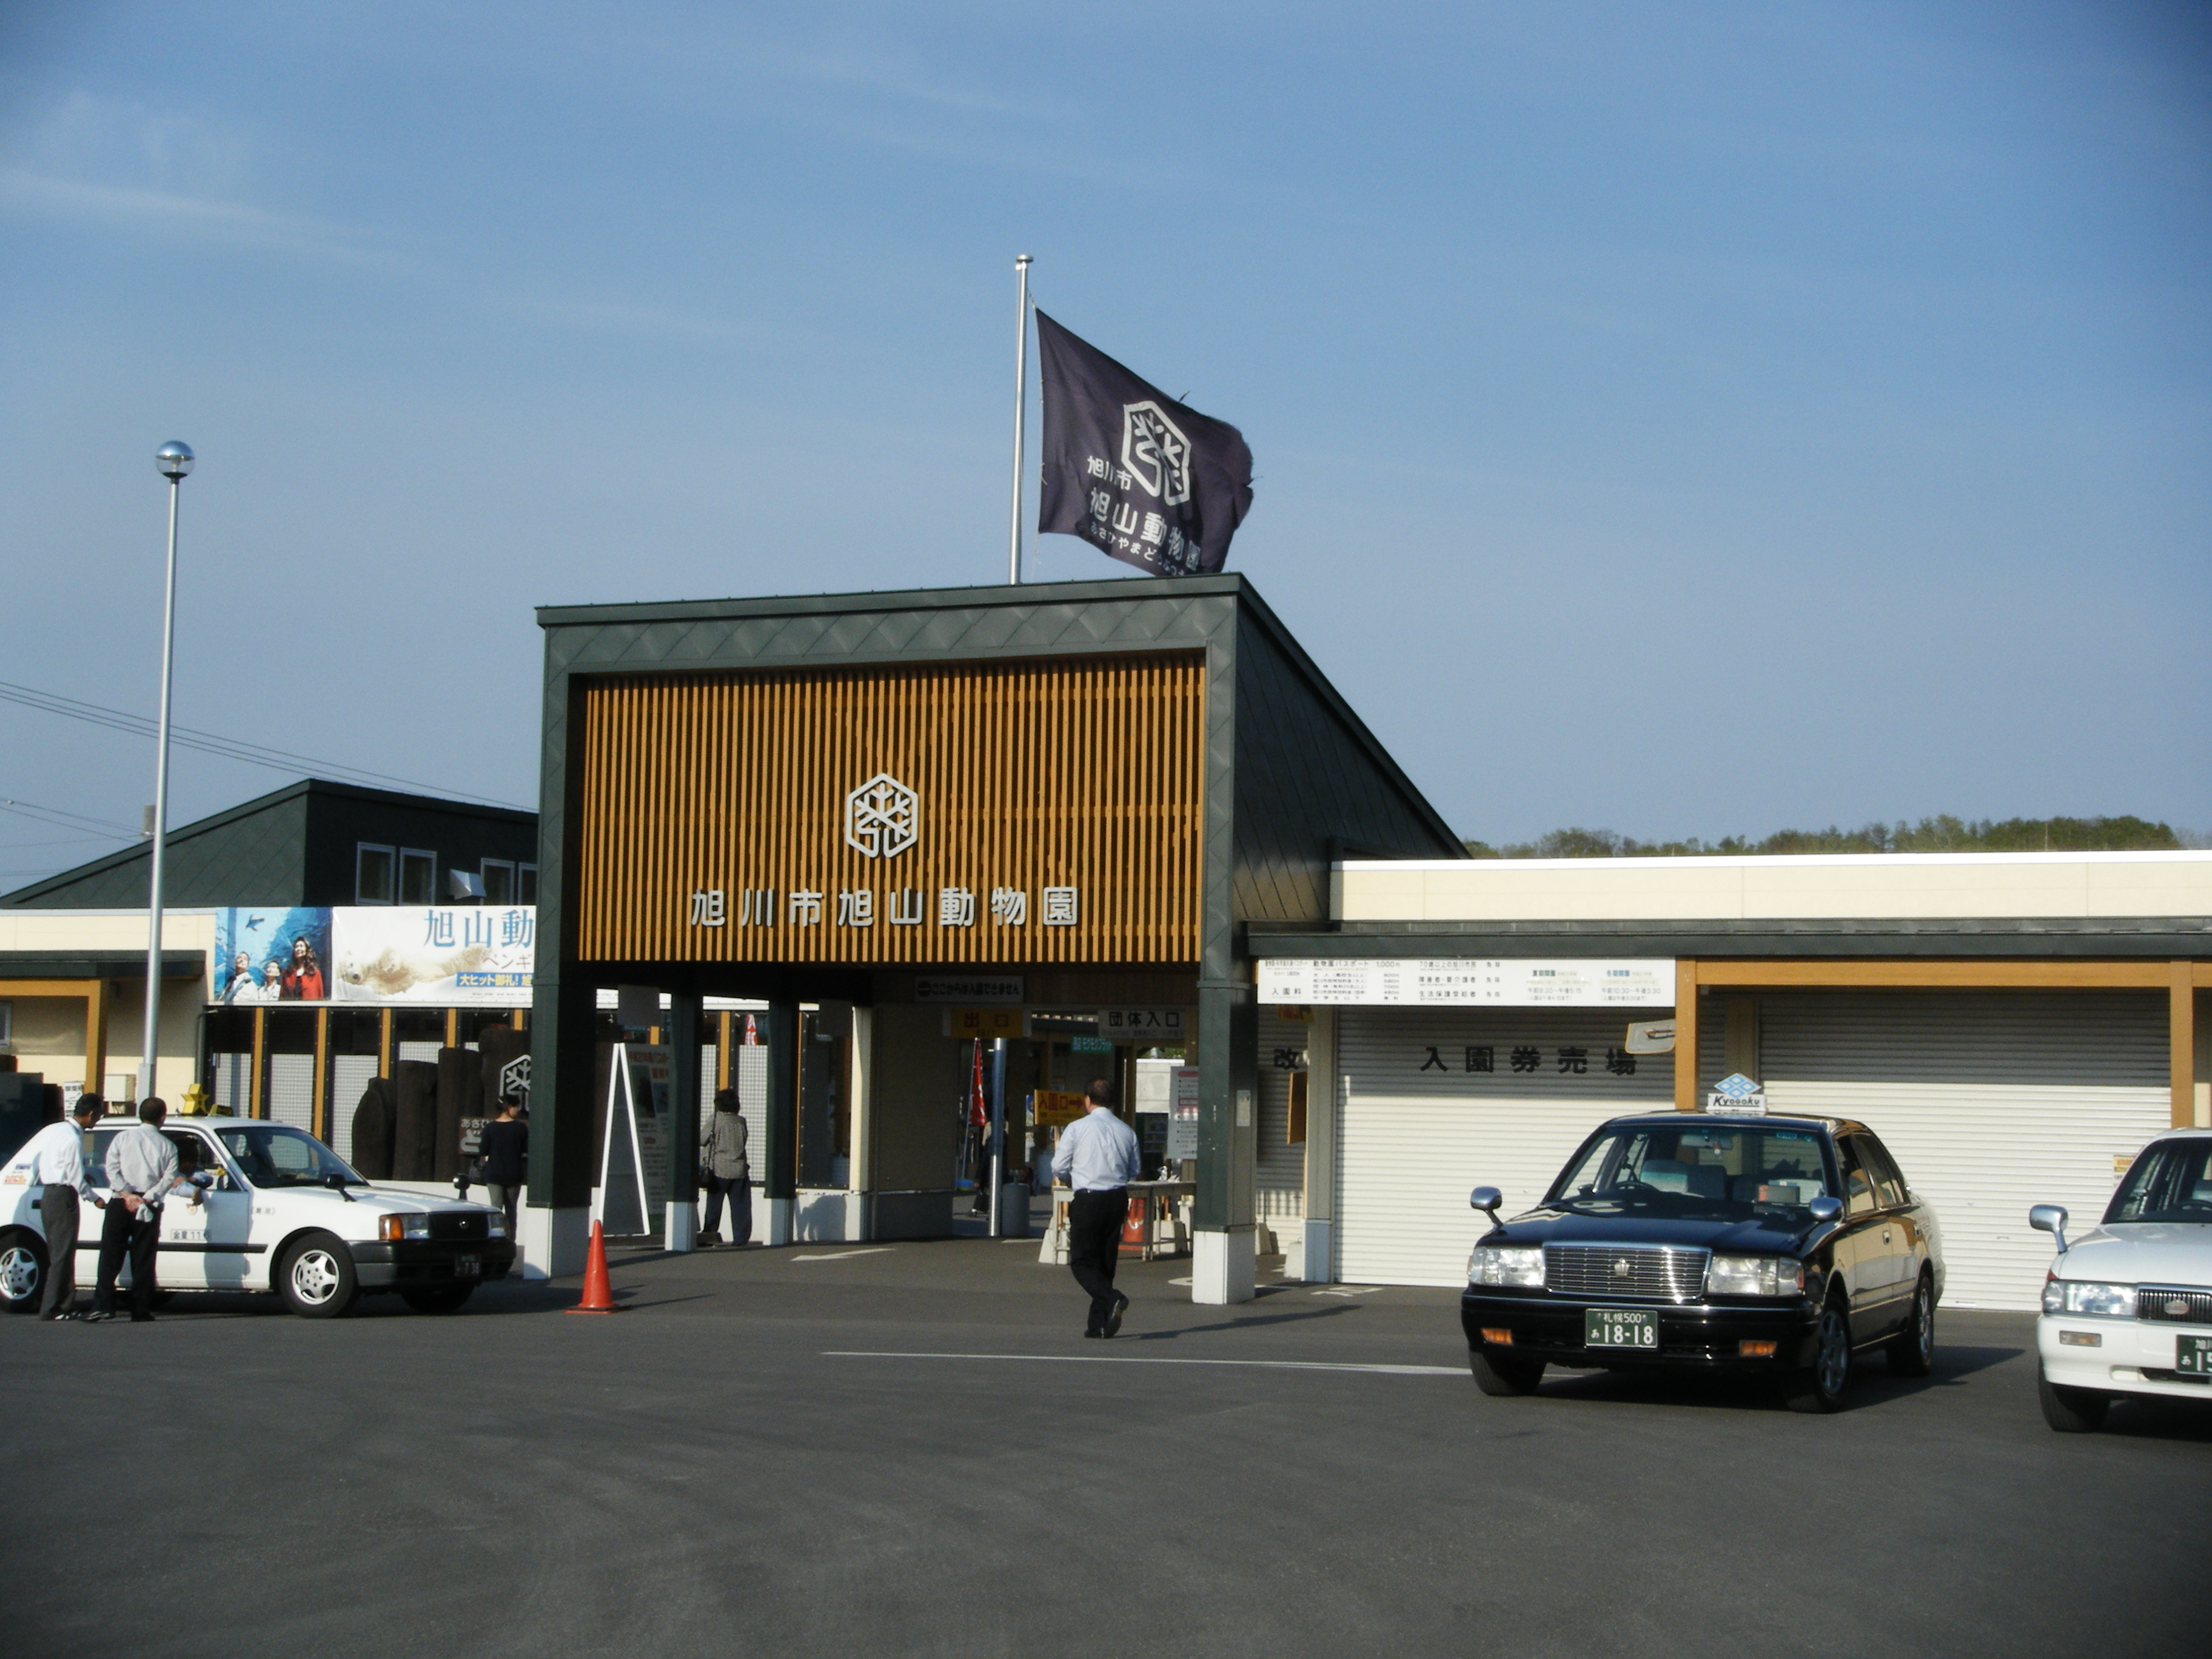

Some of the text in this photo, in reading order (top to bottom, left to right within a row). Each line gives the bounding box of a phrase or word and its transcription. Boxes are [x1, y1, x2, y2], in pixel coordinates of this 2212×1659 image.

[1087, 455, 1133, 491] 旭川市
[1090, 486, 1201, 572] 旭山動物園
[691, 886, 1078, 927] 旭川市旭山動物園
[423, 909, 534, 950] 旭山動
[481, 954, 532, 970] ペンギ
[964, 1011, 1009, 1027] 出口
[1109, 1011, 1180, 1028] 団体入口
[1419, 1046, 1637, 1076] 入園券売場
[1604, 1324, 1654, 1344] 18-18
